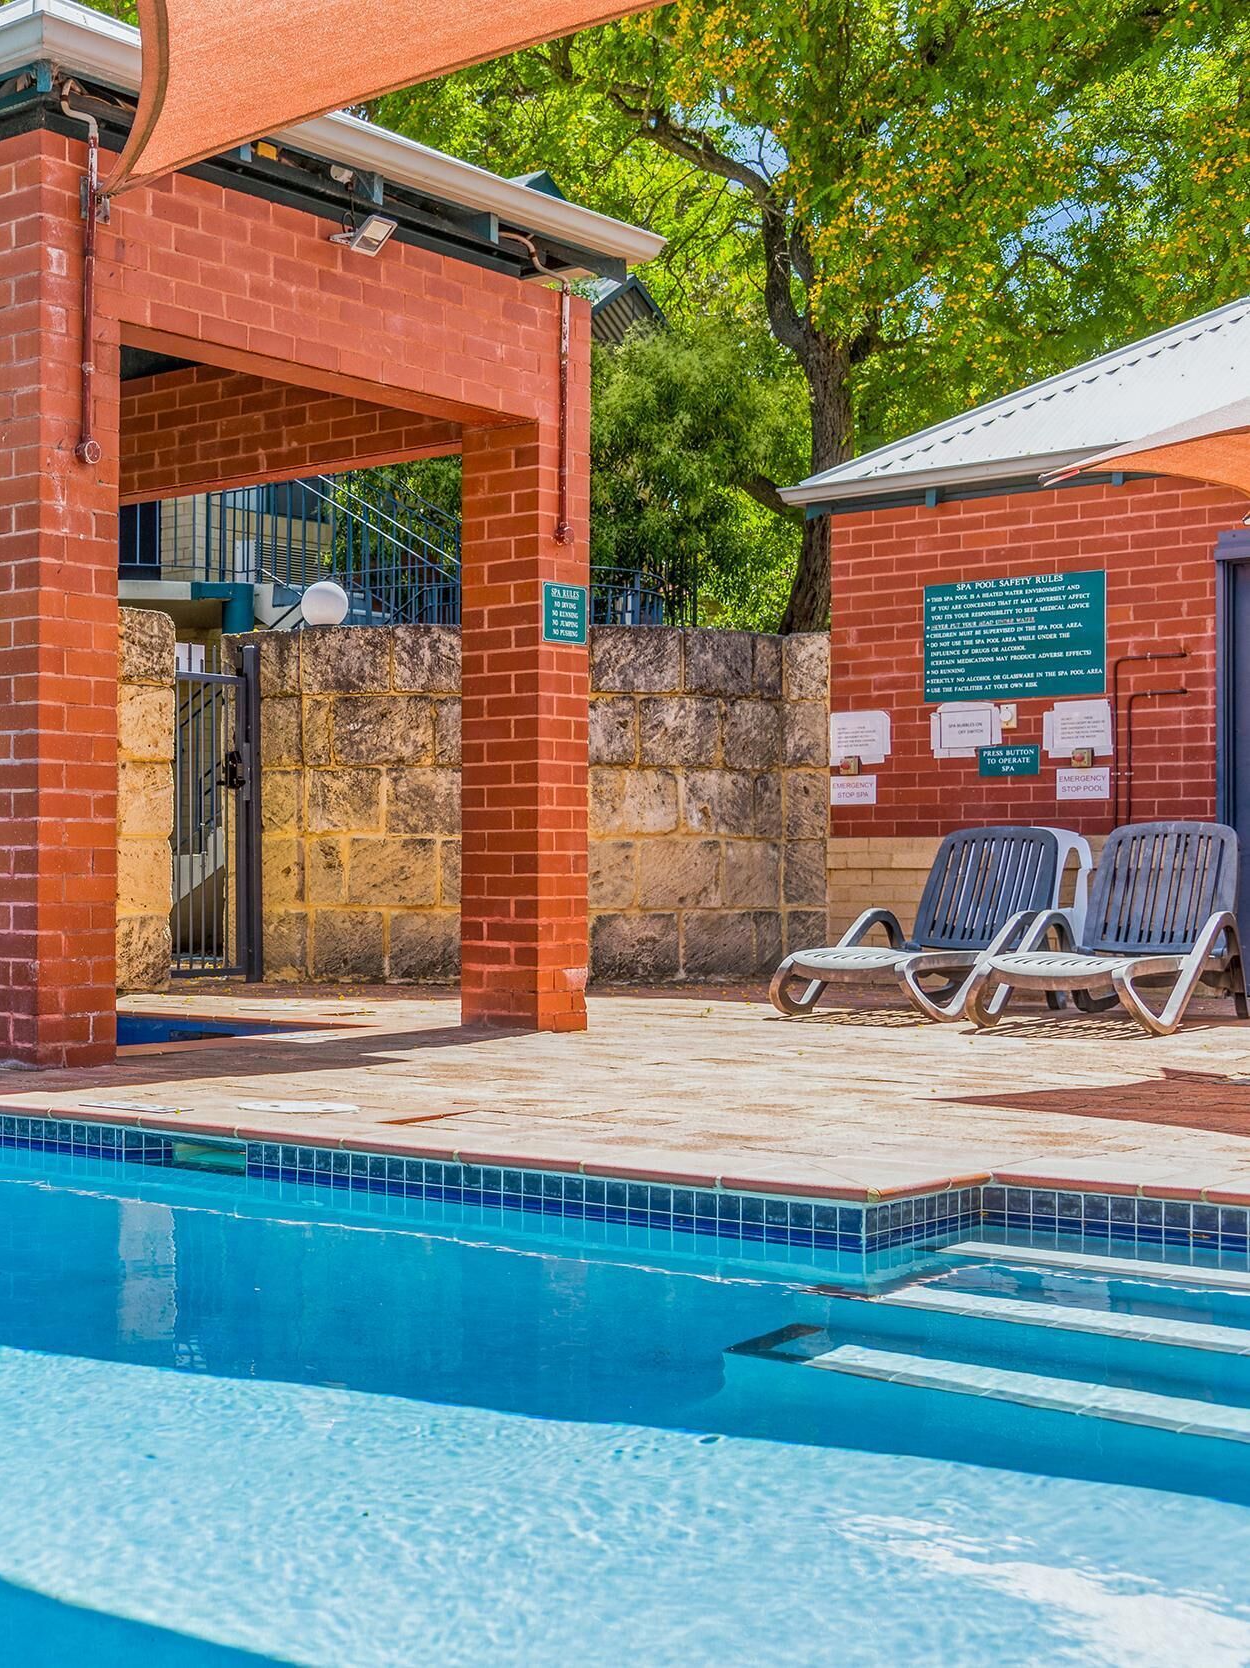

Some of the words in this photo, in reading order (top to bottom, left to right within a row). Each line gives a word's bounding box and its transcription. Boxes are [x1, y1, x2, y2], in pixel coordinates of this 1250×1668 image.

[999, 578, 1032, 587] SAFETY
[1036, 574, 1063, 584] RULES
[551, 588, 560, 596] SPA
[563, 590, 579, 598] RULES
[971, 609, 1013, 617] RESPONSIBILITY
[1059, 774, 1106, 782] EMERGENCY
